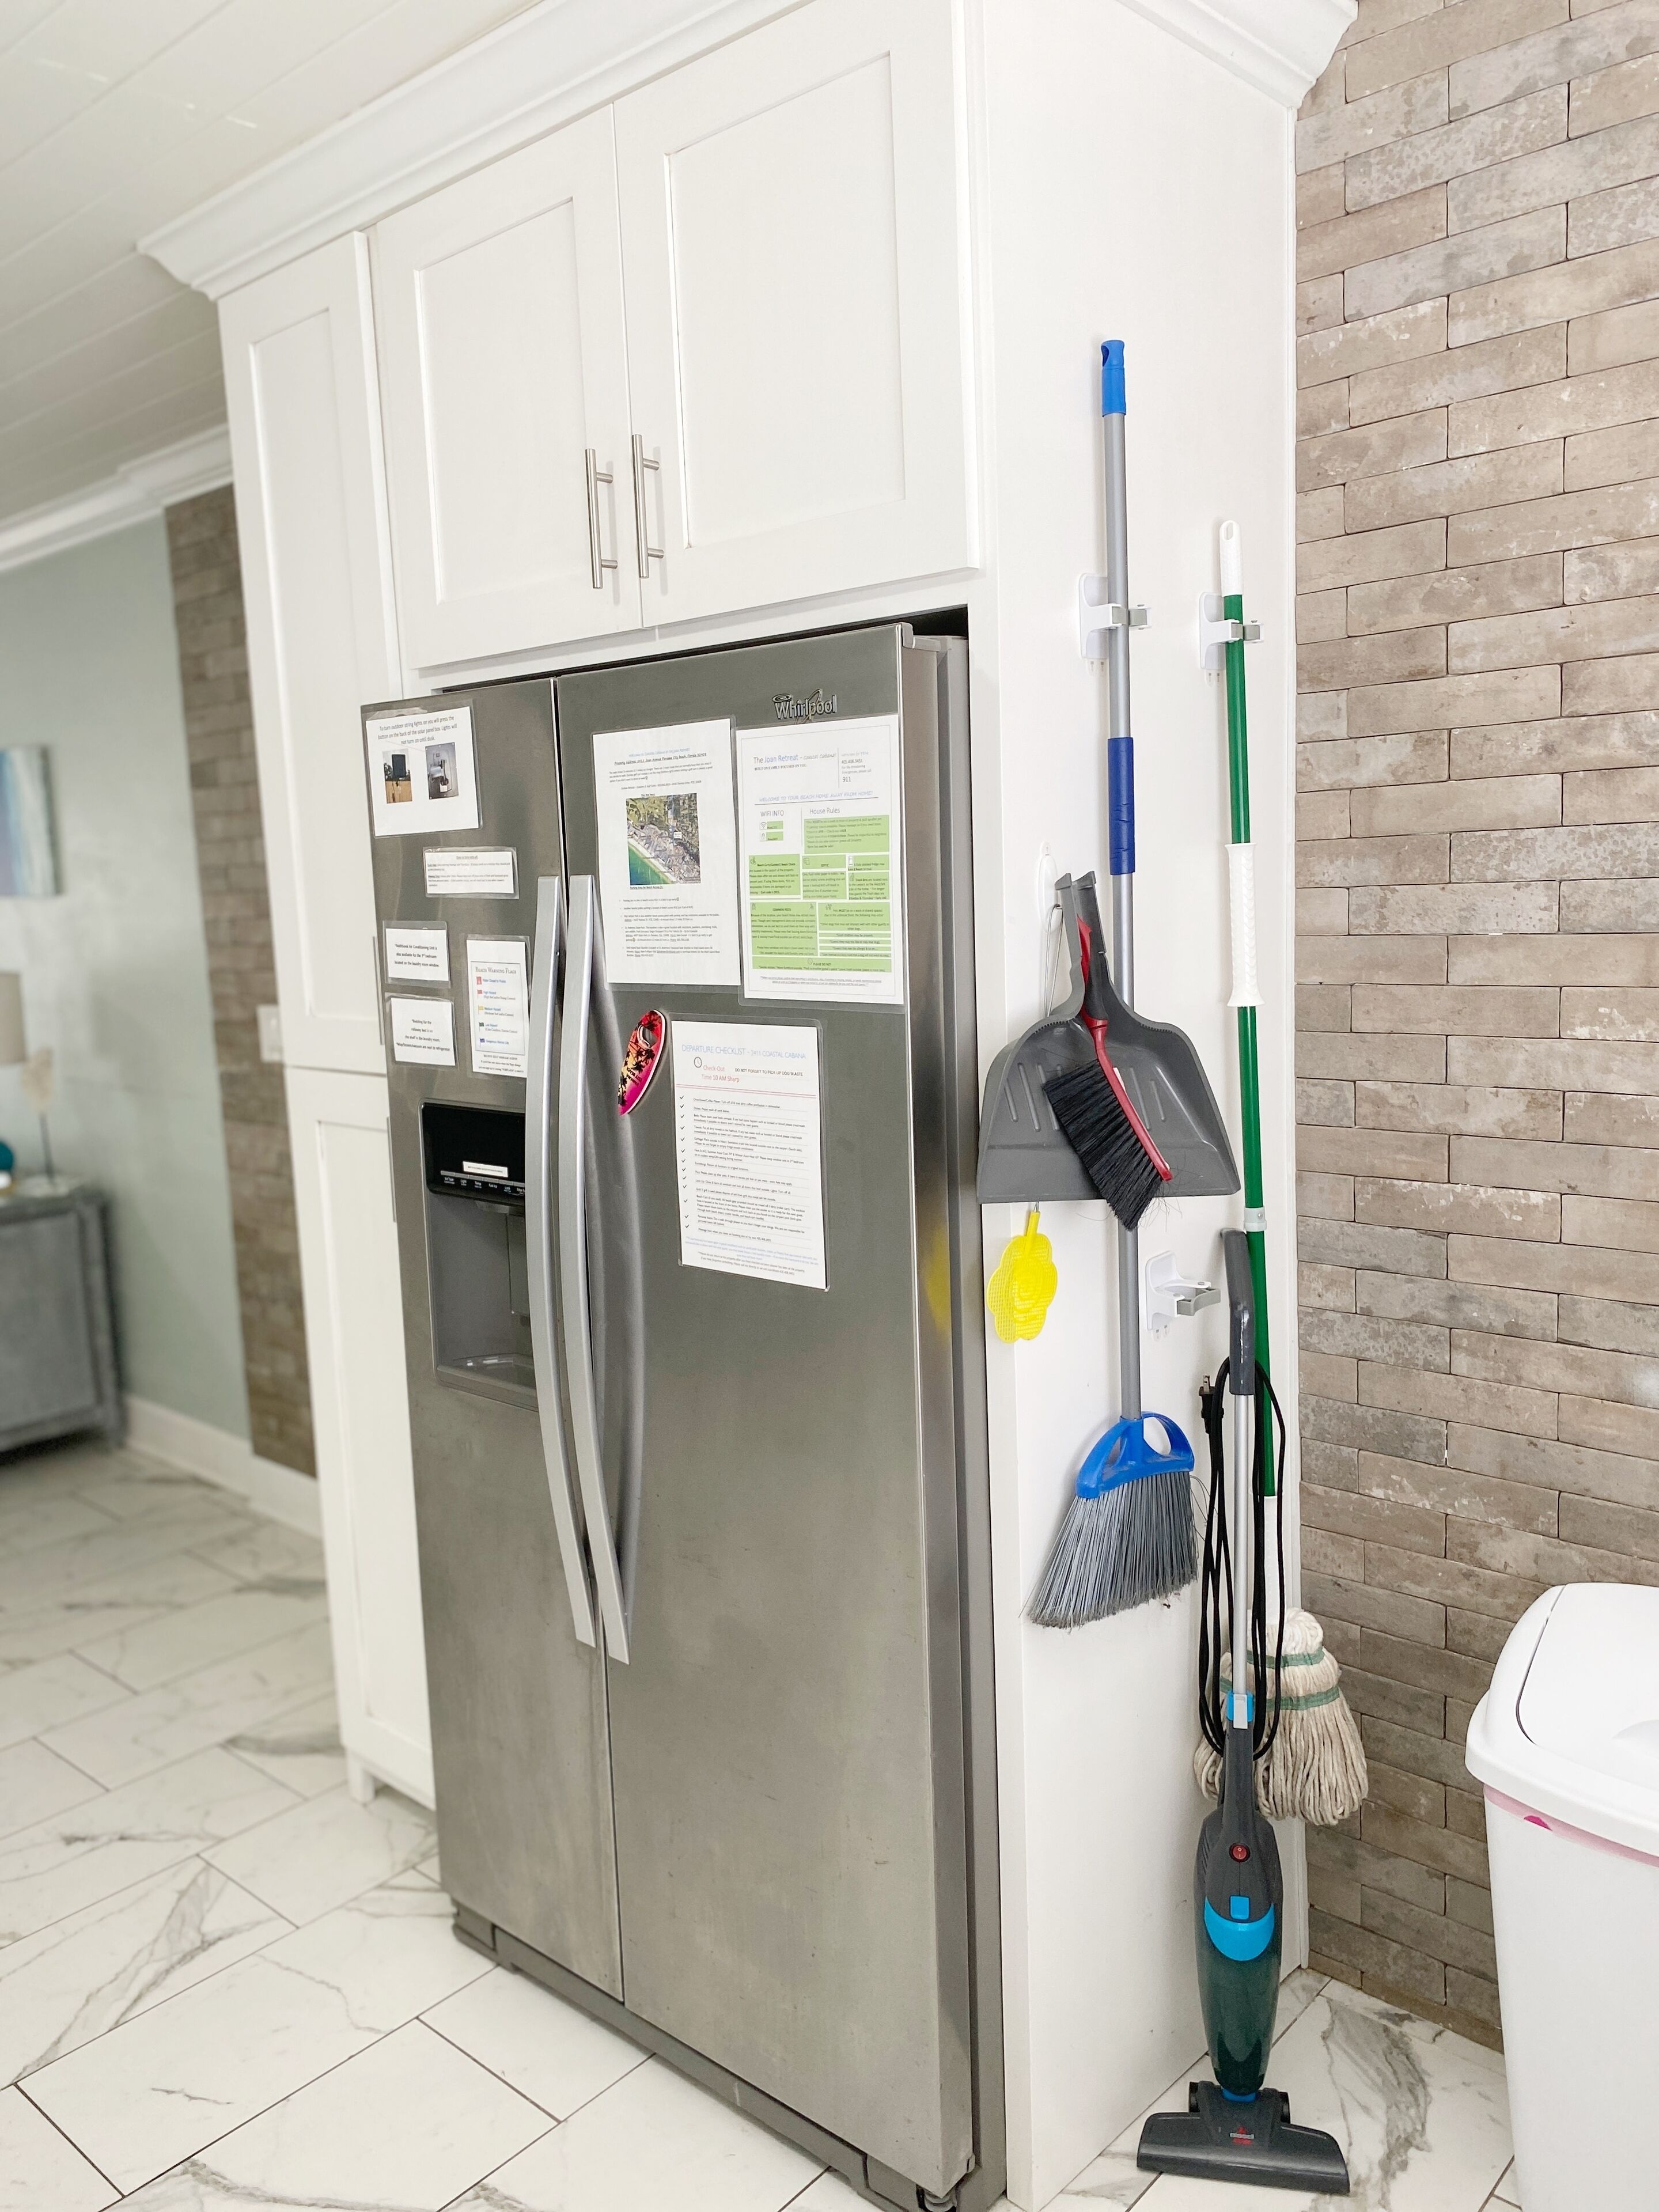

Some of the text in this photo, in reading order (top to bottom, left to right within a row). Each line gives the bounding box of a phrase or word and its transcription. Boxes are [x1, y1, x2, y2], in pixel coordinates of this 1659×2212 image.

[775, 695, 837, 719] Whirlpool
[682, 1044, 714, 1054] DEPARTURE
[715, 1046, 746, 1055] CHECKLIST
